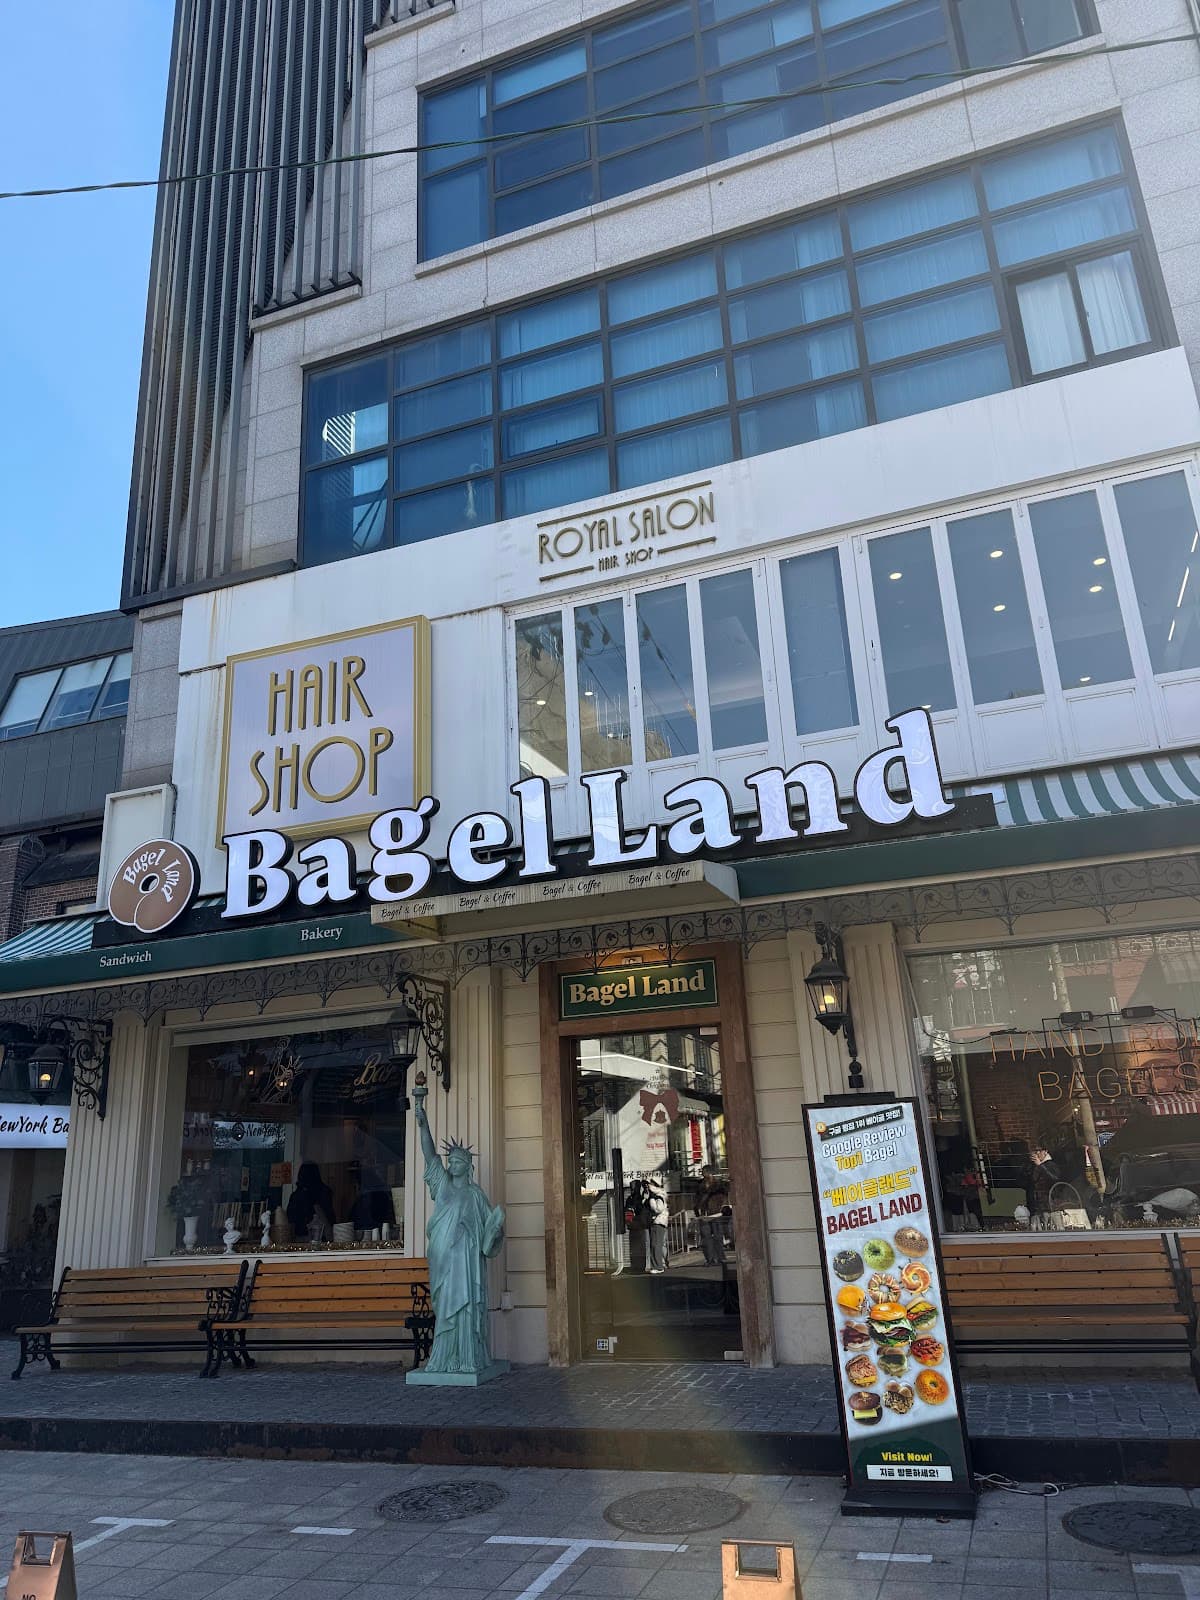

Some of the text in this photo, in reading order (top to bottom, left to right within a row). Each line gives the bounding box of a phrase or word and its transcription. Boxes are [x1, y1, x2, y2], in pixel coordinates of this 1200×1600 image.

[538, 491, 715, 564] ROYAL SALON
[598, 546, 654, 572] HAIR SHOP
[267, 655, 373, 737] HAIR
[248, 726, 394, 817] SHOP
[122, 848, 181, 903] Bagel Land
[628, 871, 653, 886] Bagel
[665, 867, 691, 882] Coffee
[459, 894, 482, 909] Bagel
[493, 890, 516, 905] Coffee
[542, 883, 566, 898] Bagel
[577, 879, 601, 894] Coffee
[381, 905, 403, 920] Bagel
[413, 902, 435, 915] Coffee
[300, 925, 343, 942] Bakery
[99, 950, 152, 968] Sandwich
[568, 968, 706, 1007] Bagel Land
[990, 1028, 1104, 1063] HAND
[0, 1115, 49, 1134] ewYork
[828, 1125, 842, 1137] 구글
[866, 1114, 885, 1126] 베이글
[821, 1124, 907, 1159] Google Review
[864, 1142, 898, 1164] Bagel
[826, 1193, 923, 1235] BAGEL LAND
[881, 1451, 933, 1462] Visit Now!
[879, 1468, 939, 1478] 지금 방문하세요!
